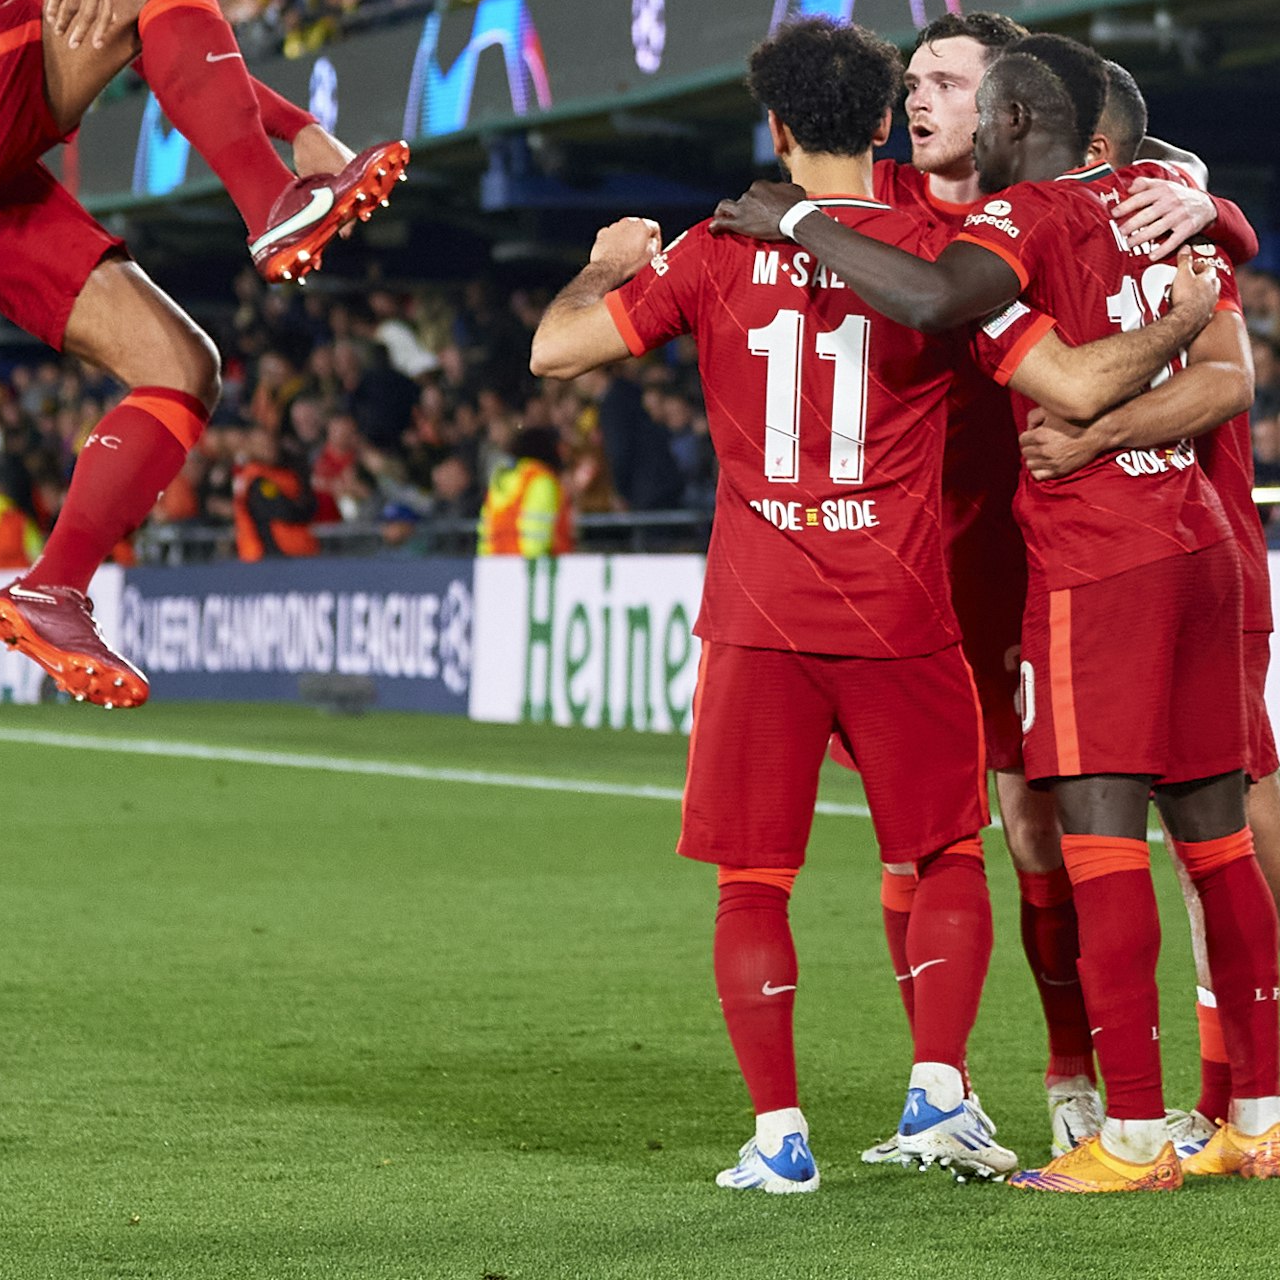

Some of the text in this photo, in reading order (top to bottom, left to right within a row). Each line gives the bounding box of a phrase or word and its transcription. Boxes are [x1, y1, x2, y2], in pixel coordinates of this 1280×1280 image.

[748, 309, 871, 484] 11
[821, 499, 880, 532] SIDE
[204, 592, 334, 671] CHAMPIONS
[337, 592, 438, 678] LEAGUE
[522, 557, 692, 729] Heine
